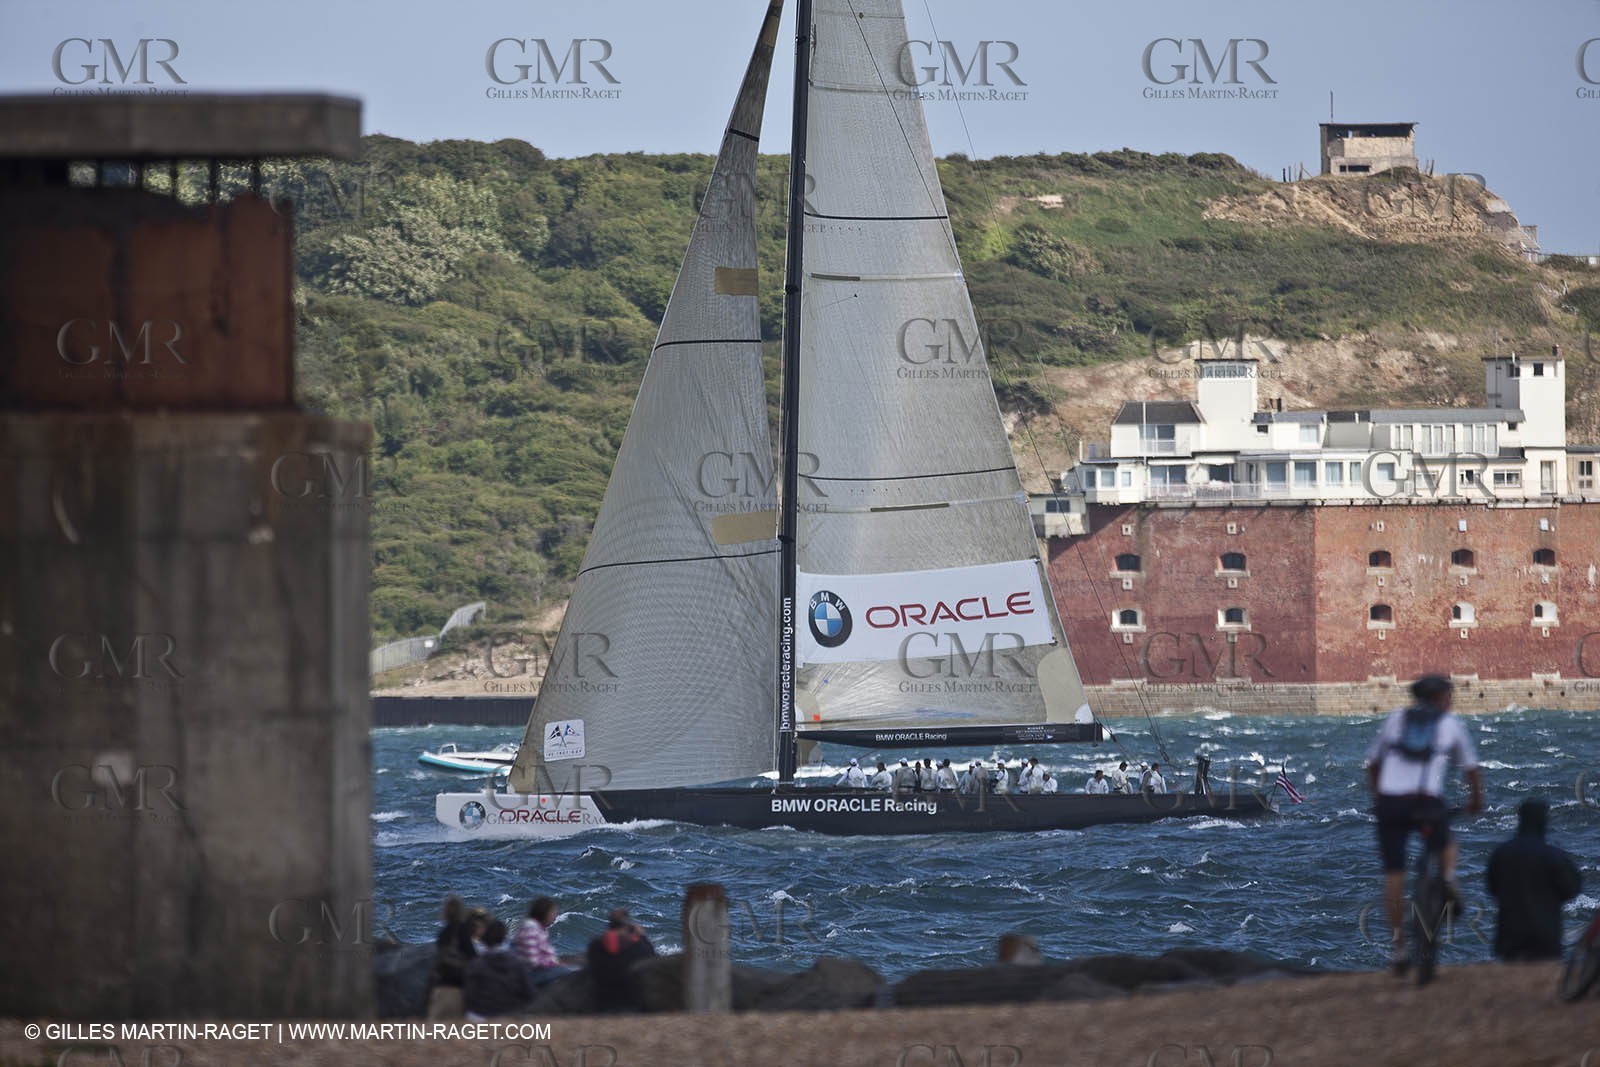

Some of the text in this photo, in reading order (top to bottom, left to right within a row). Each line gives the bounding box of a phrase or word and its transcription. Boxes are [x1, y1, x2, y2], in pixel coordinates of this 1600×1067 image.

[865, 591, 1034, 629] ORACLE
[780, 597, 793, 730] bmworacleracing.com
[875, 734, 894, 742] BMW
[894, 732, 924, 741] ORACLE
[770, 798, 937, 815] BMW ORACLE Racing
[499, 809, 582, 823] ORACLE
